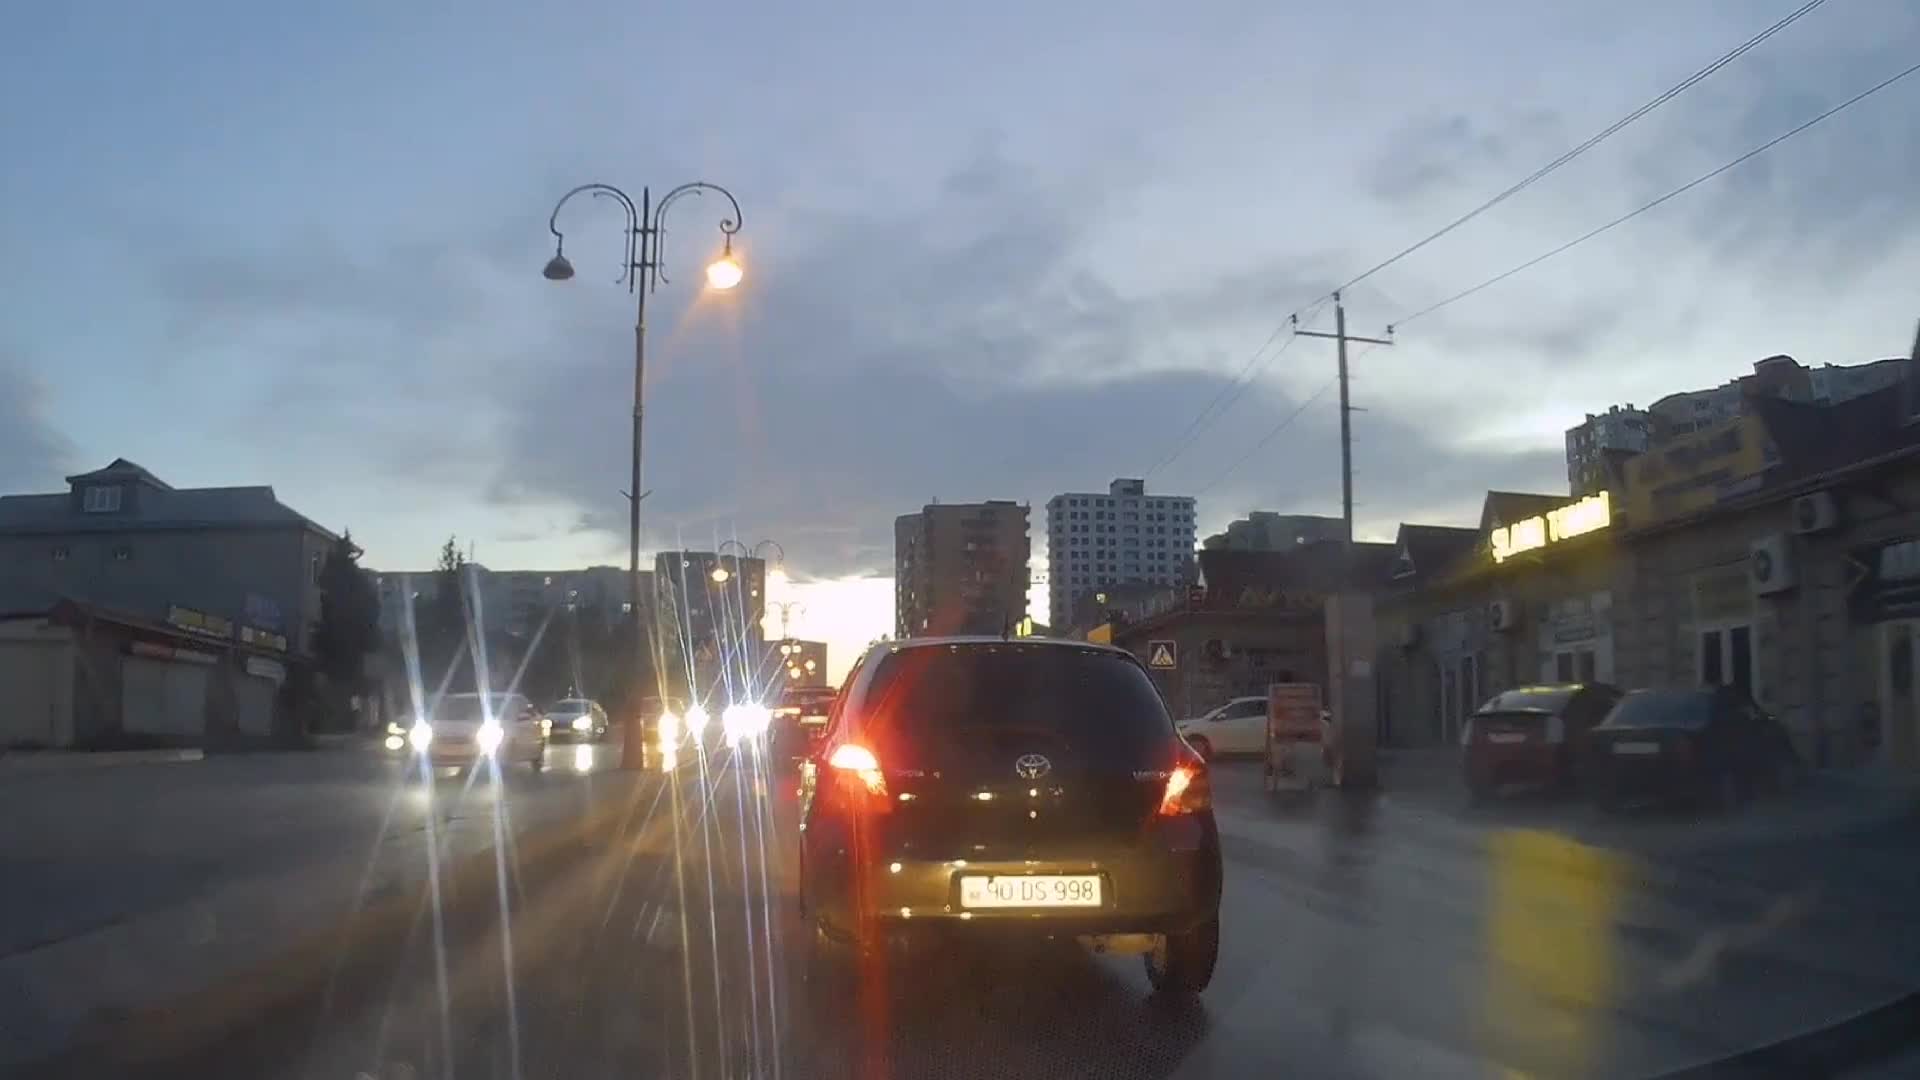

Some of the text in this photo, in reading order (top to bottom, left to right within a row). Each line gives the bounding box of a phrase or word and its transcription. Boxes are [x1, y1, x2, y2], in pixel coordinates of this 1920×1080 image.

[986, 879, 1014, 901] 90
[1021, 880, 1047, 901] DS
[1054, 879, 1094, 901] 998
